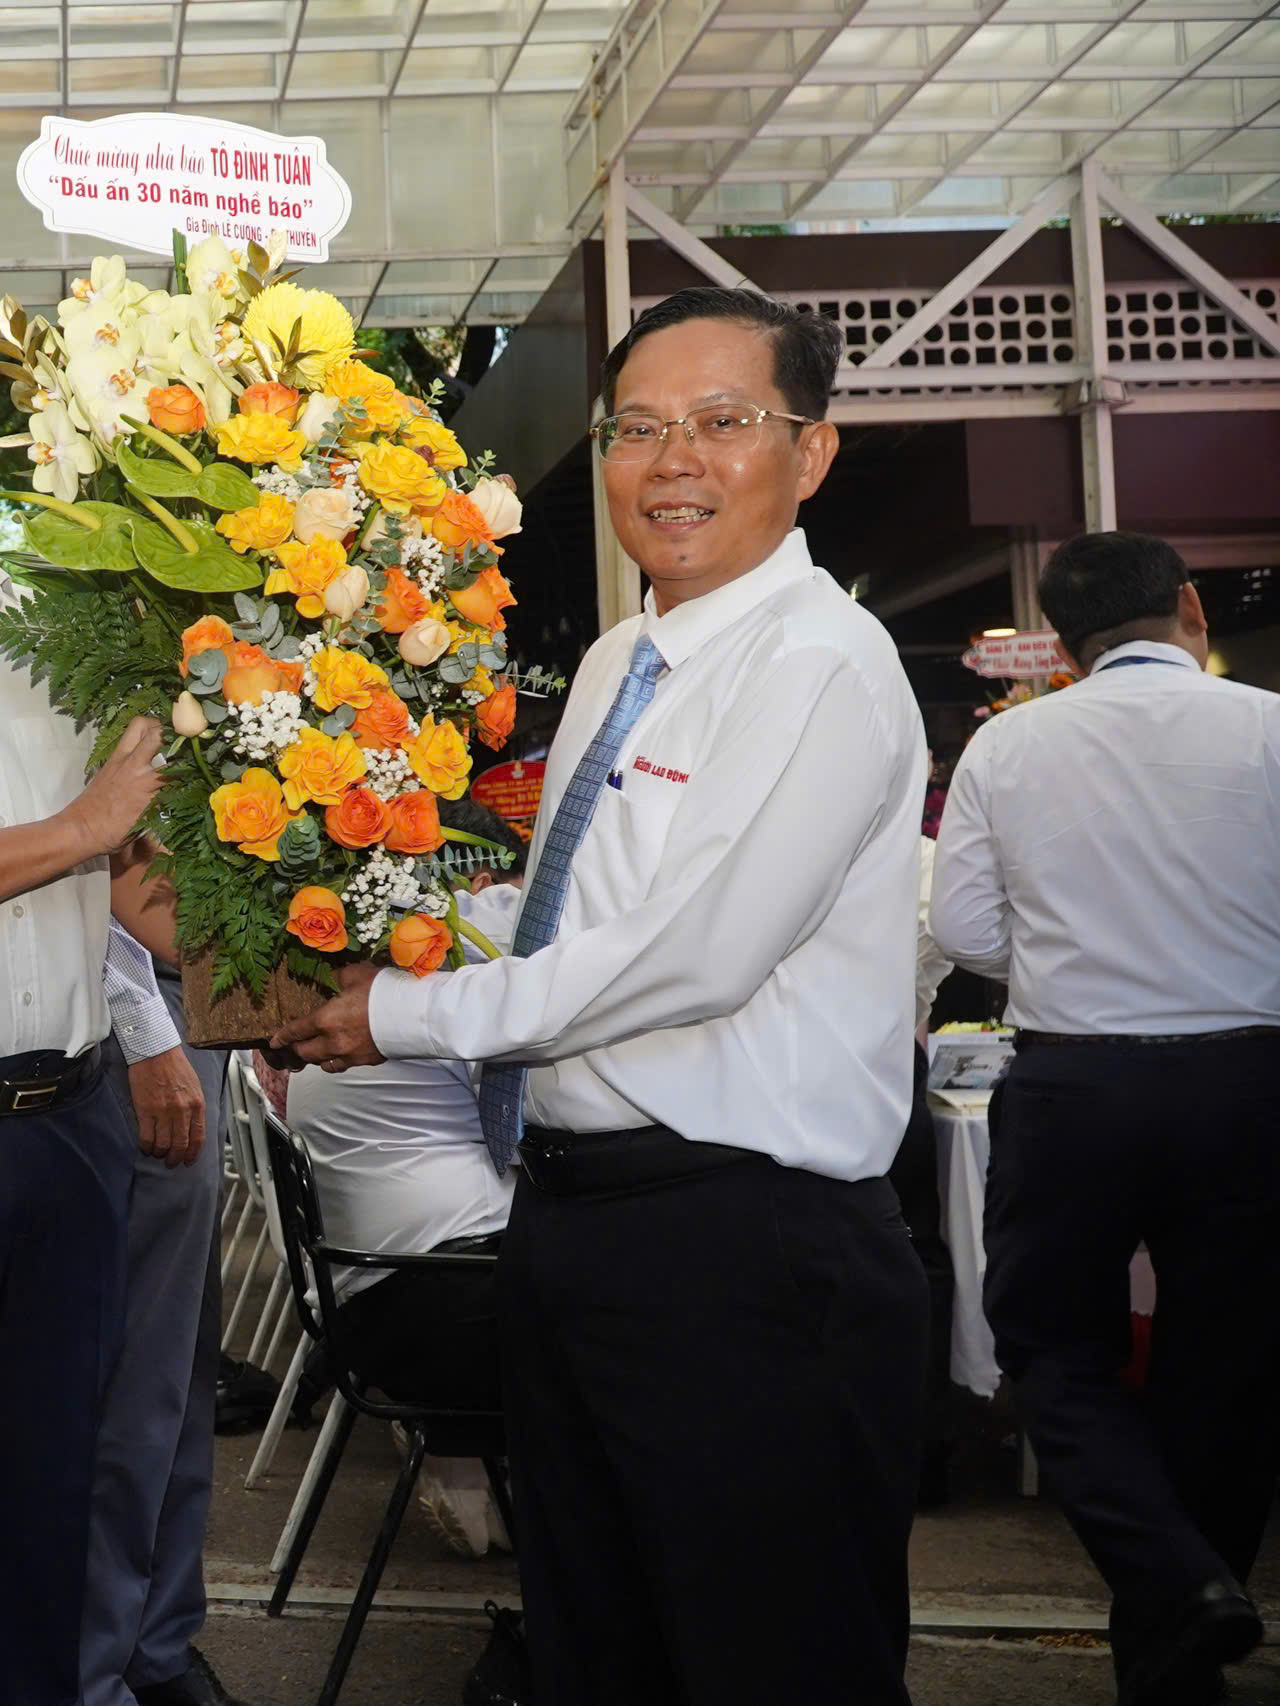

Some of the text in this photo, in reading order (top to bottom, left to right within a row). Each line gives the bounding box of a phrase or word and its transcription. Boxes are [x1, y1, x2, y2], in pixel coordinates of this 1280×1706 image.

[54, 134, 92, 166] Chúc
[210, 141, 229, 178] TÔ
[233, 142, 269, 182] ĐÌNH
[106, 178, 130, 202] ấn
[138, 182, 161, 203] 30
[170, 185, 209, 208] năm
[216, 191, 261, 217] nghề
[186, 216, 200, 233] Gia
